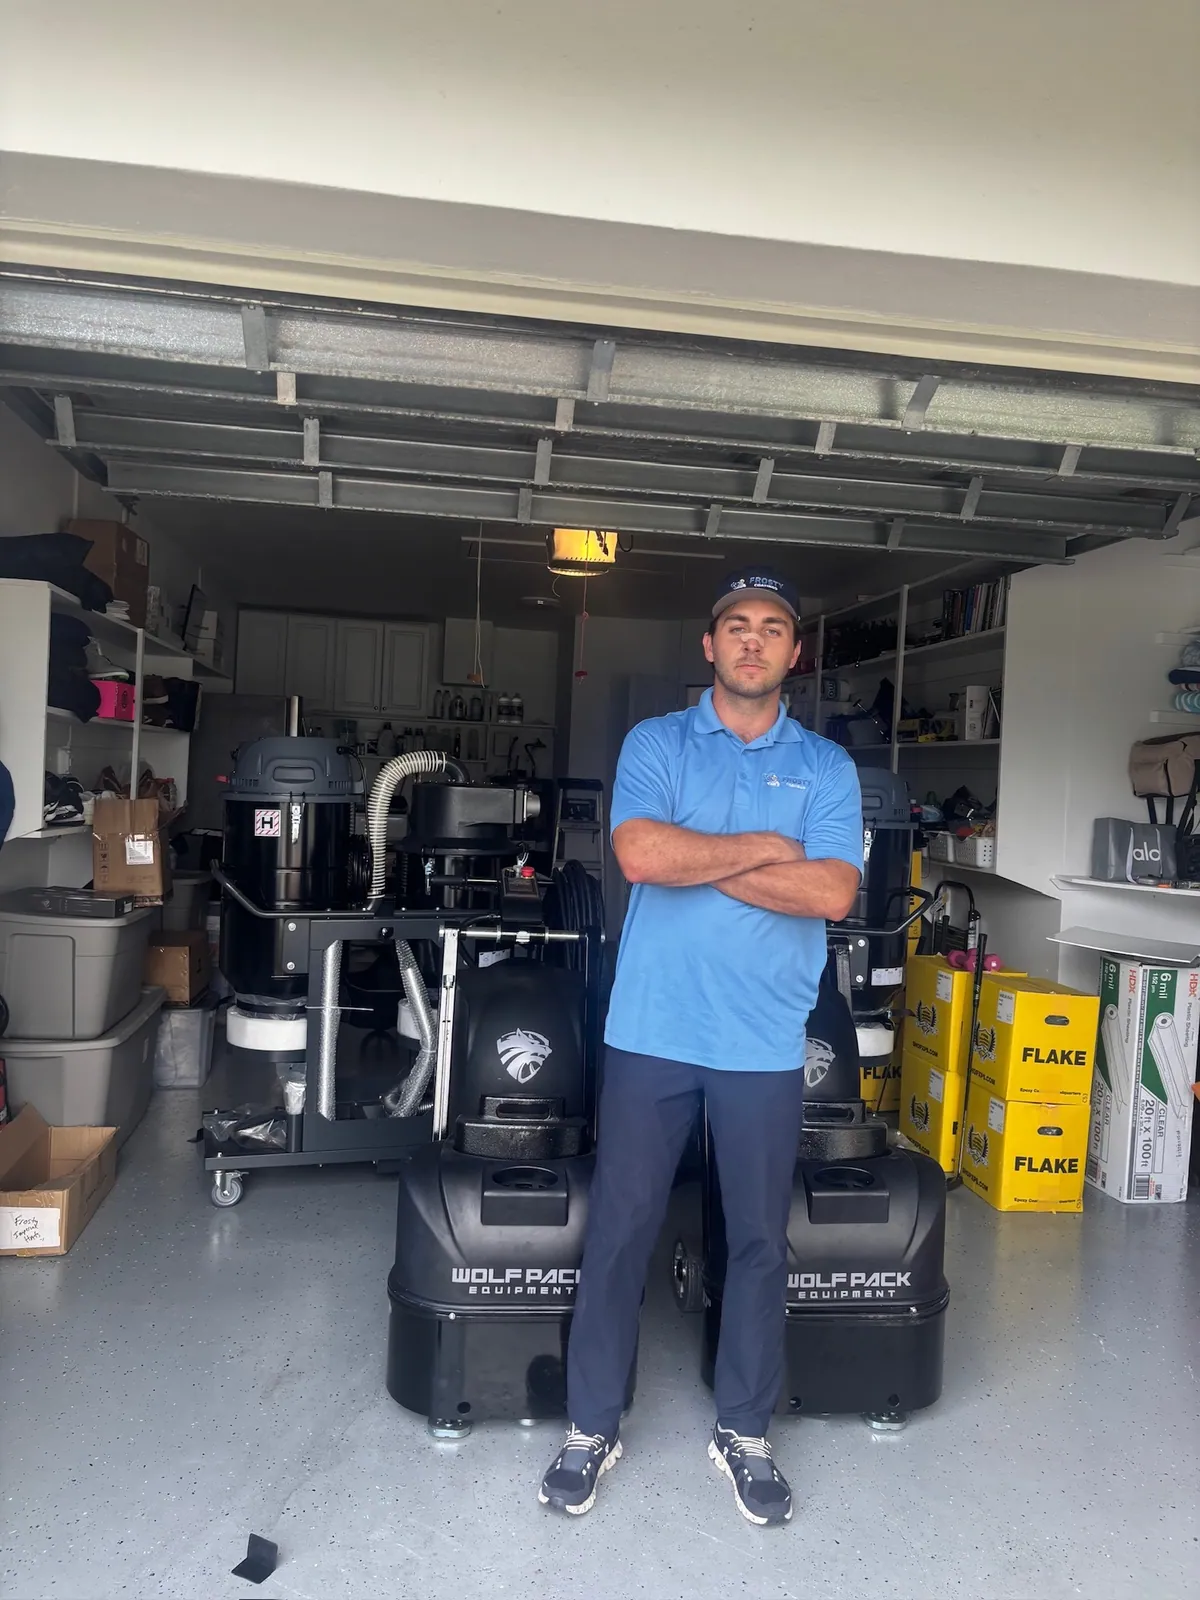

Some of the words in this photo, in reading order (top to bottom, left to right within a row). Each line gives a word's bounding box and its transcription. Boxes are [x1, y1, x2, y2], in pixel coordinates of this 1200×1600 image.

[749, 576, 784, 589] FROSTY
[782, 776, 811, 786] FROSTY
[261, 816, 274, 829] H
[1133, 841, 1161, 862] alo
[1128, 969, 1137, 994] HDX
[1188, 973, 1199, 997] HDX
[1022, 1047, 1087, 1066] FLAKE
[1157, 1108, 1166, 1138] CLEAR
[1014, 1156, 1079, 1174] FLAKE
[15, 1215, 38, 1227] Frosty
[451, 1268, 523, 1284] WOLF
[850, 1271, 912, 1287] PACK
[468, 1286, 574, 1295] EQUIPMENT
[798, 1289, 896, 1299] EQUIPMENT
